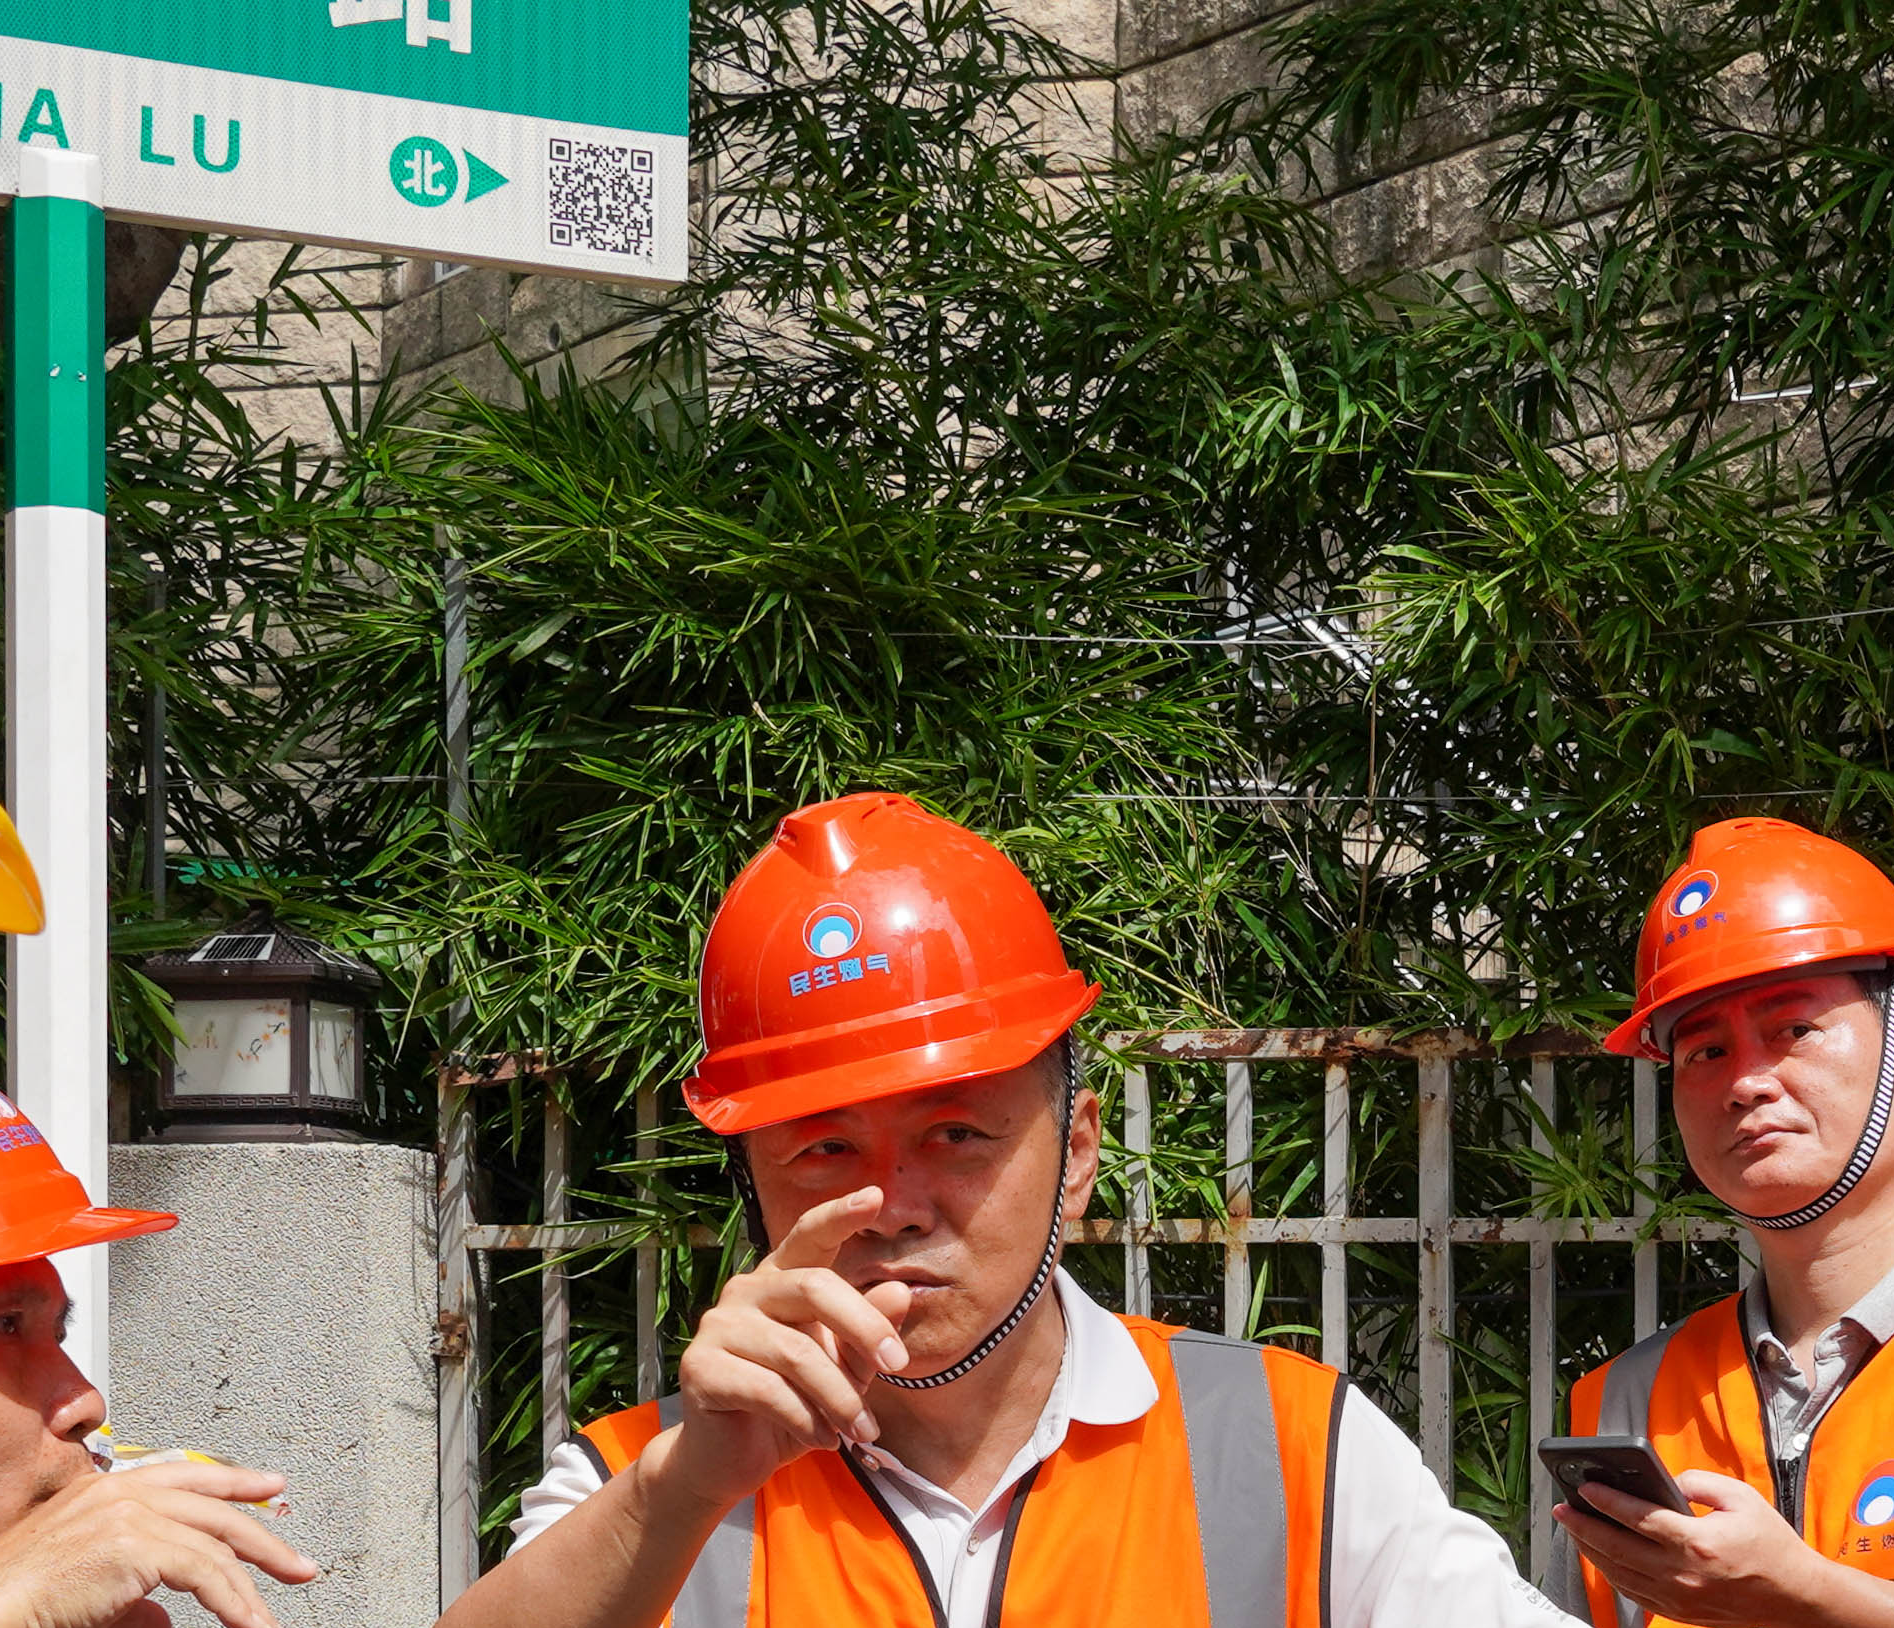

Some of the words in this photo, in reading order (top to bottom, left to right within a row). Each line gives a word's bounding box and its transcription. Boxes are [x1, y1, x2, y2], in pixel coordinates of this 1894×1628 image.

[140, 105, 241, 174] LU
[402, 148, 448, 197] 北
[788, 953, 891, 998] 民生燃气
